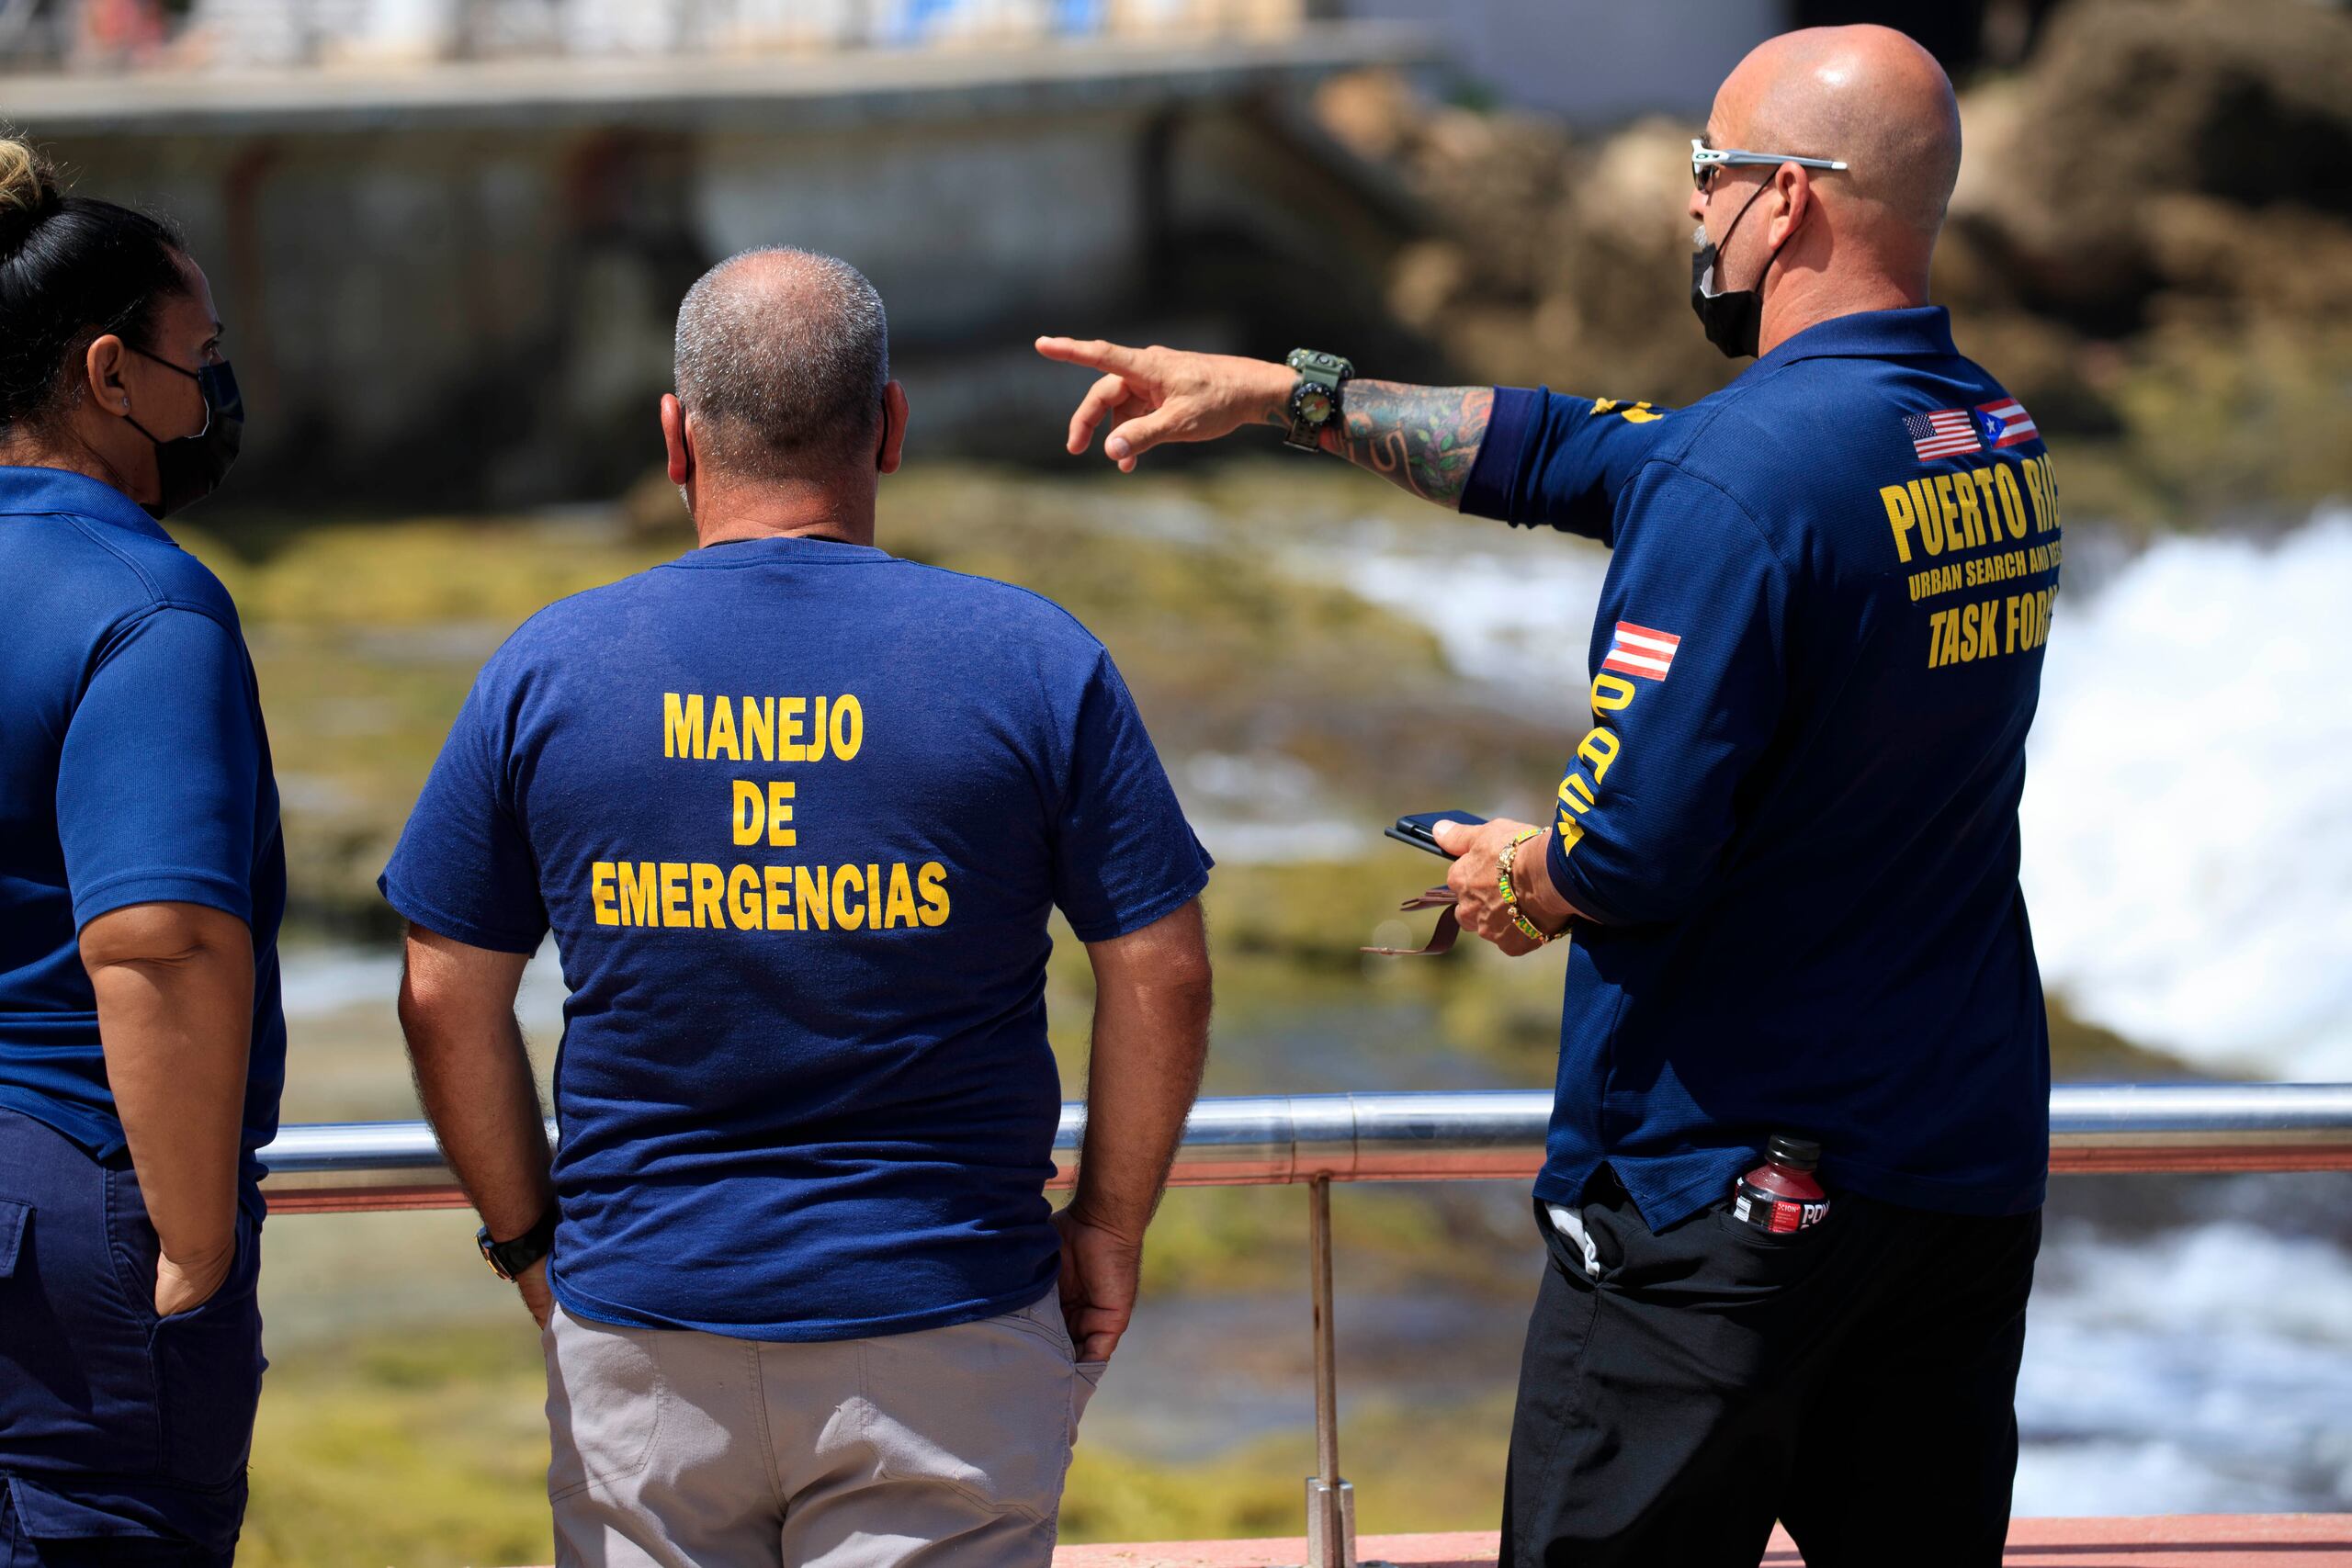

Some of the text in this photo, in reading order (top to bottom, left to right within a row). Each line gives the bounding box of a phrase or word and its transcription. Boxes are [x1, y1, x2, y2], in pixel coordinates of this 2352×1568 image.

[1879, 462, 2027, 563] PUERTO
[1908, 562, 1962, 602] URBAN
[1965, 549, 2027, 588] SEARCH
[2029, 545, 2050, 574] AND
[1928, 599, 1999, 669] TASK
[663, 693, 864, 762] MANEJO
[732, 779, 797, 847] DE
[591, 861, 951, 931] EMERGENCIAS
